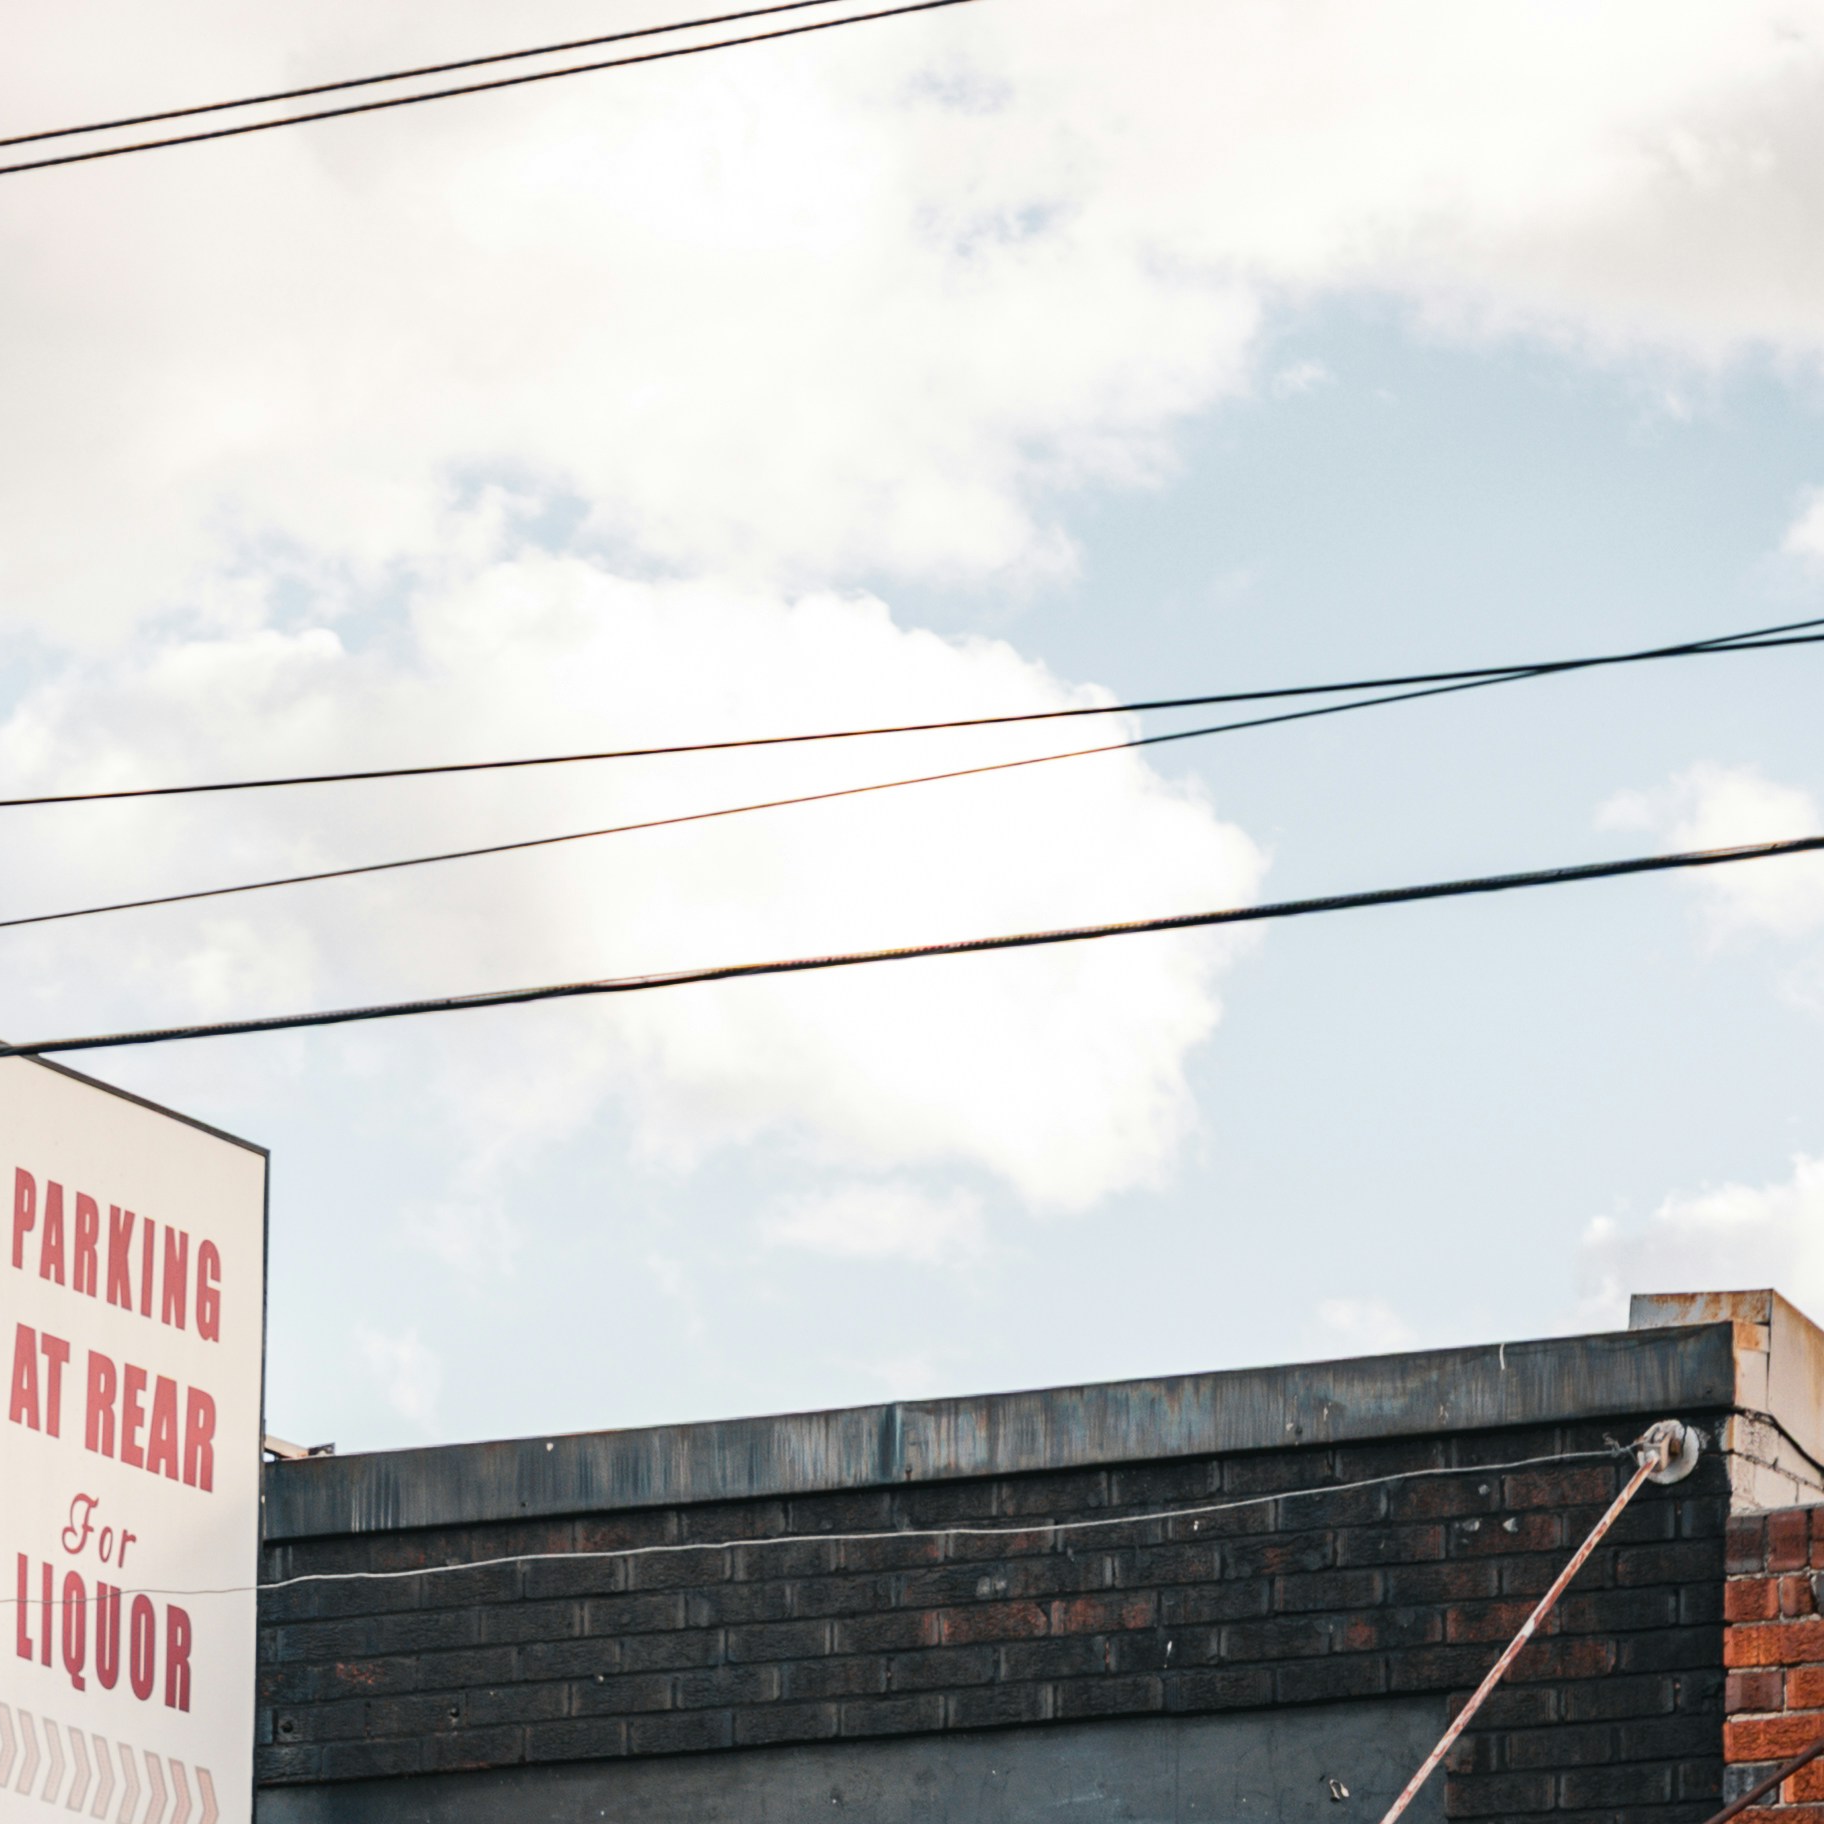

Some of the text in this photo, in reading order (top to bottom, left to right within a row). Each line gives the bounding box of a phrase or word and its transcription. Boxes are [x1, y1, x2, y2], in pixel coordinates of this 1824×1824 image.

[10, 1166, 222, 1343] PARKING
[8, 1322, 215, 1494] AT REAR
[61, 1490, 137, 1569] For
[14, 1551, 193, 1714] LIQUOR
